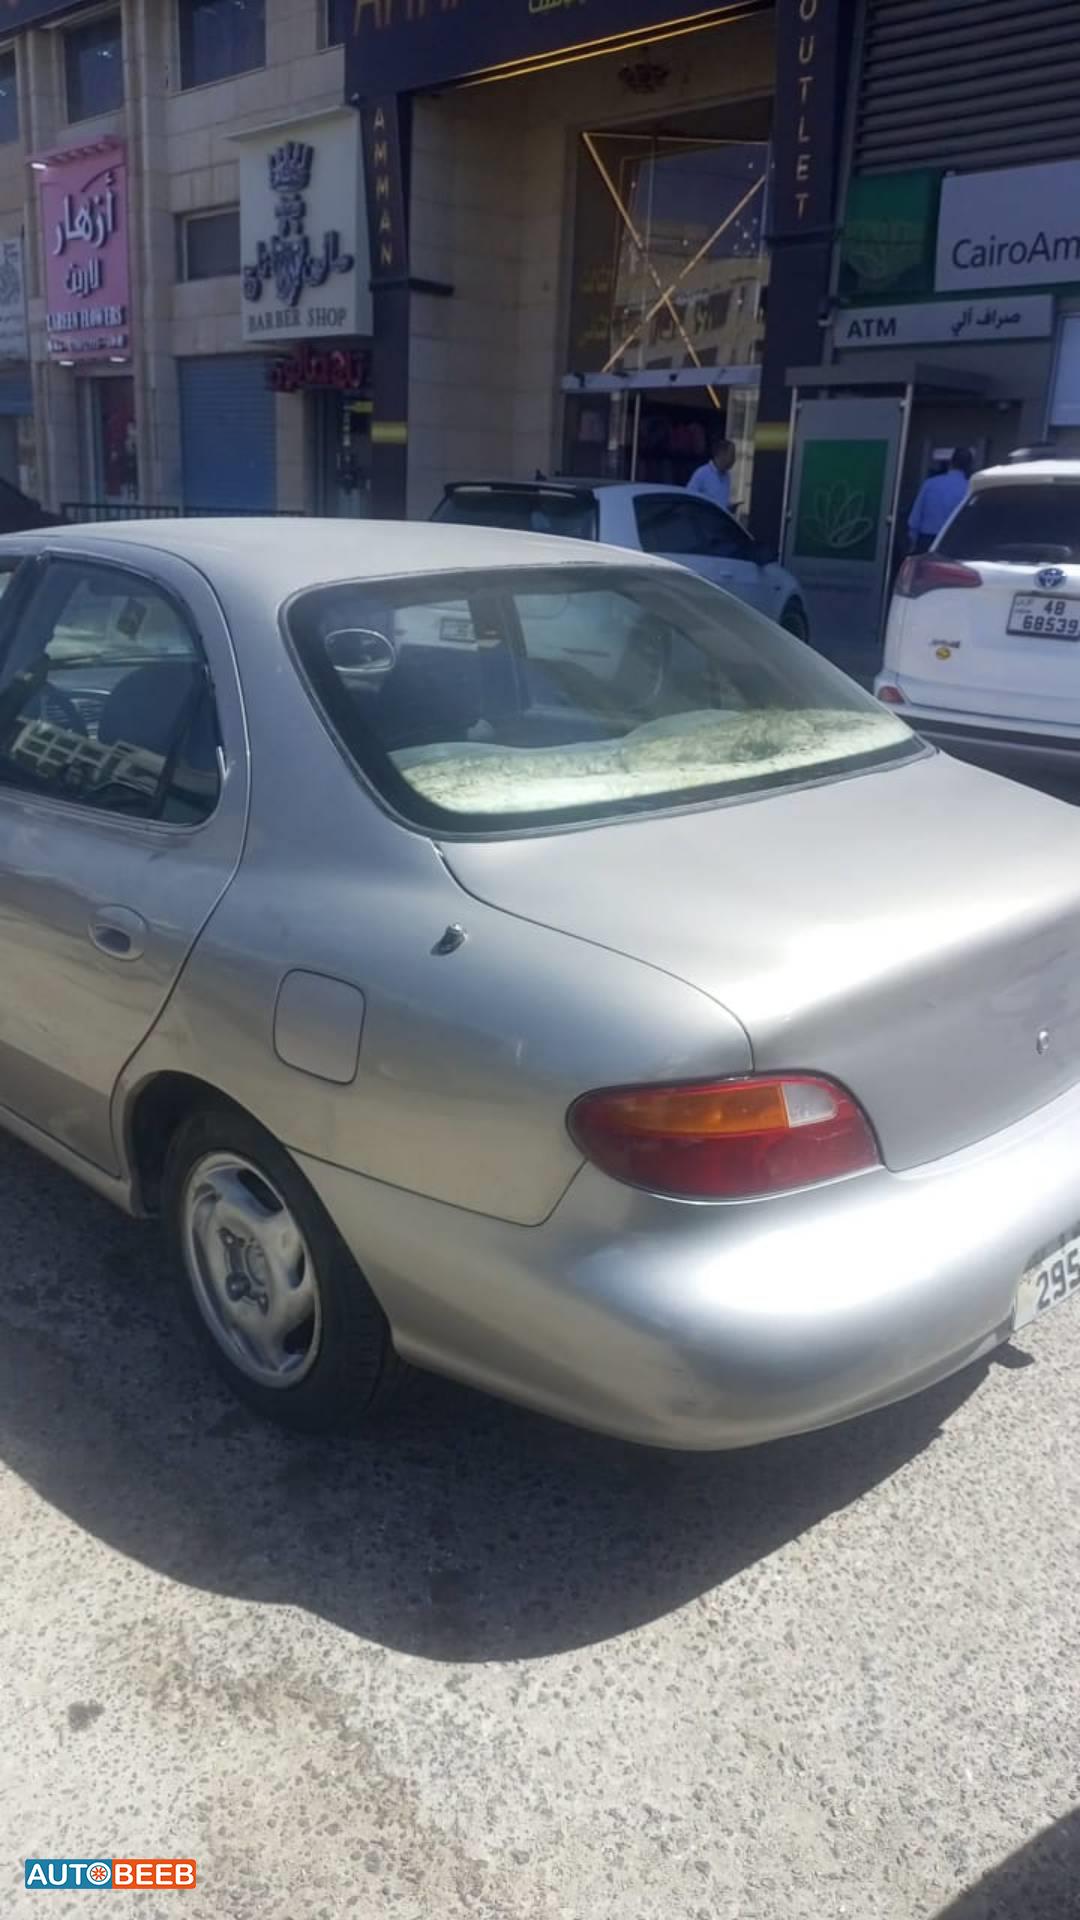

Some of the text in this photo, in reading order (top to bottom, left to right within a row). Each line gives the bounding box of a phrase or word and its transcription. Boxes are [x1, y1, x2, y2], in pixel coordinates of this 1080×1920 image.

[796, 0, 817, 219] OUTLET
[373, 107, 393, 265] AMMAN
[53, 171, 116, 255] أزهار
[952, 231, 1080, 270] CairoAm
[248, 306, 347, 333] BARBER SHOP
[847, 317, 897, 339] ATM
[1023, 615, 1079, 634] 68539
[1036, 1247, 1080, 1311] 295
